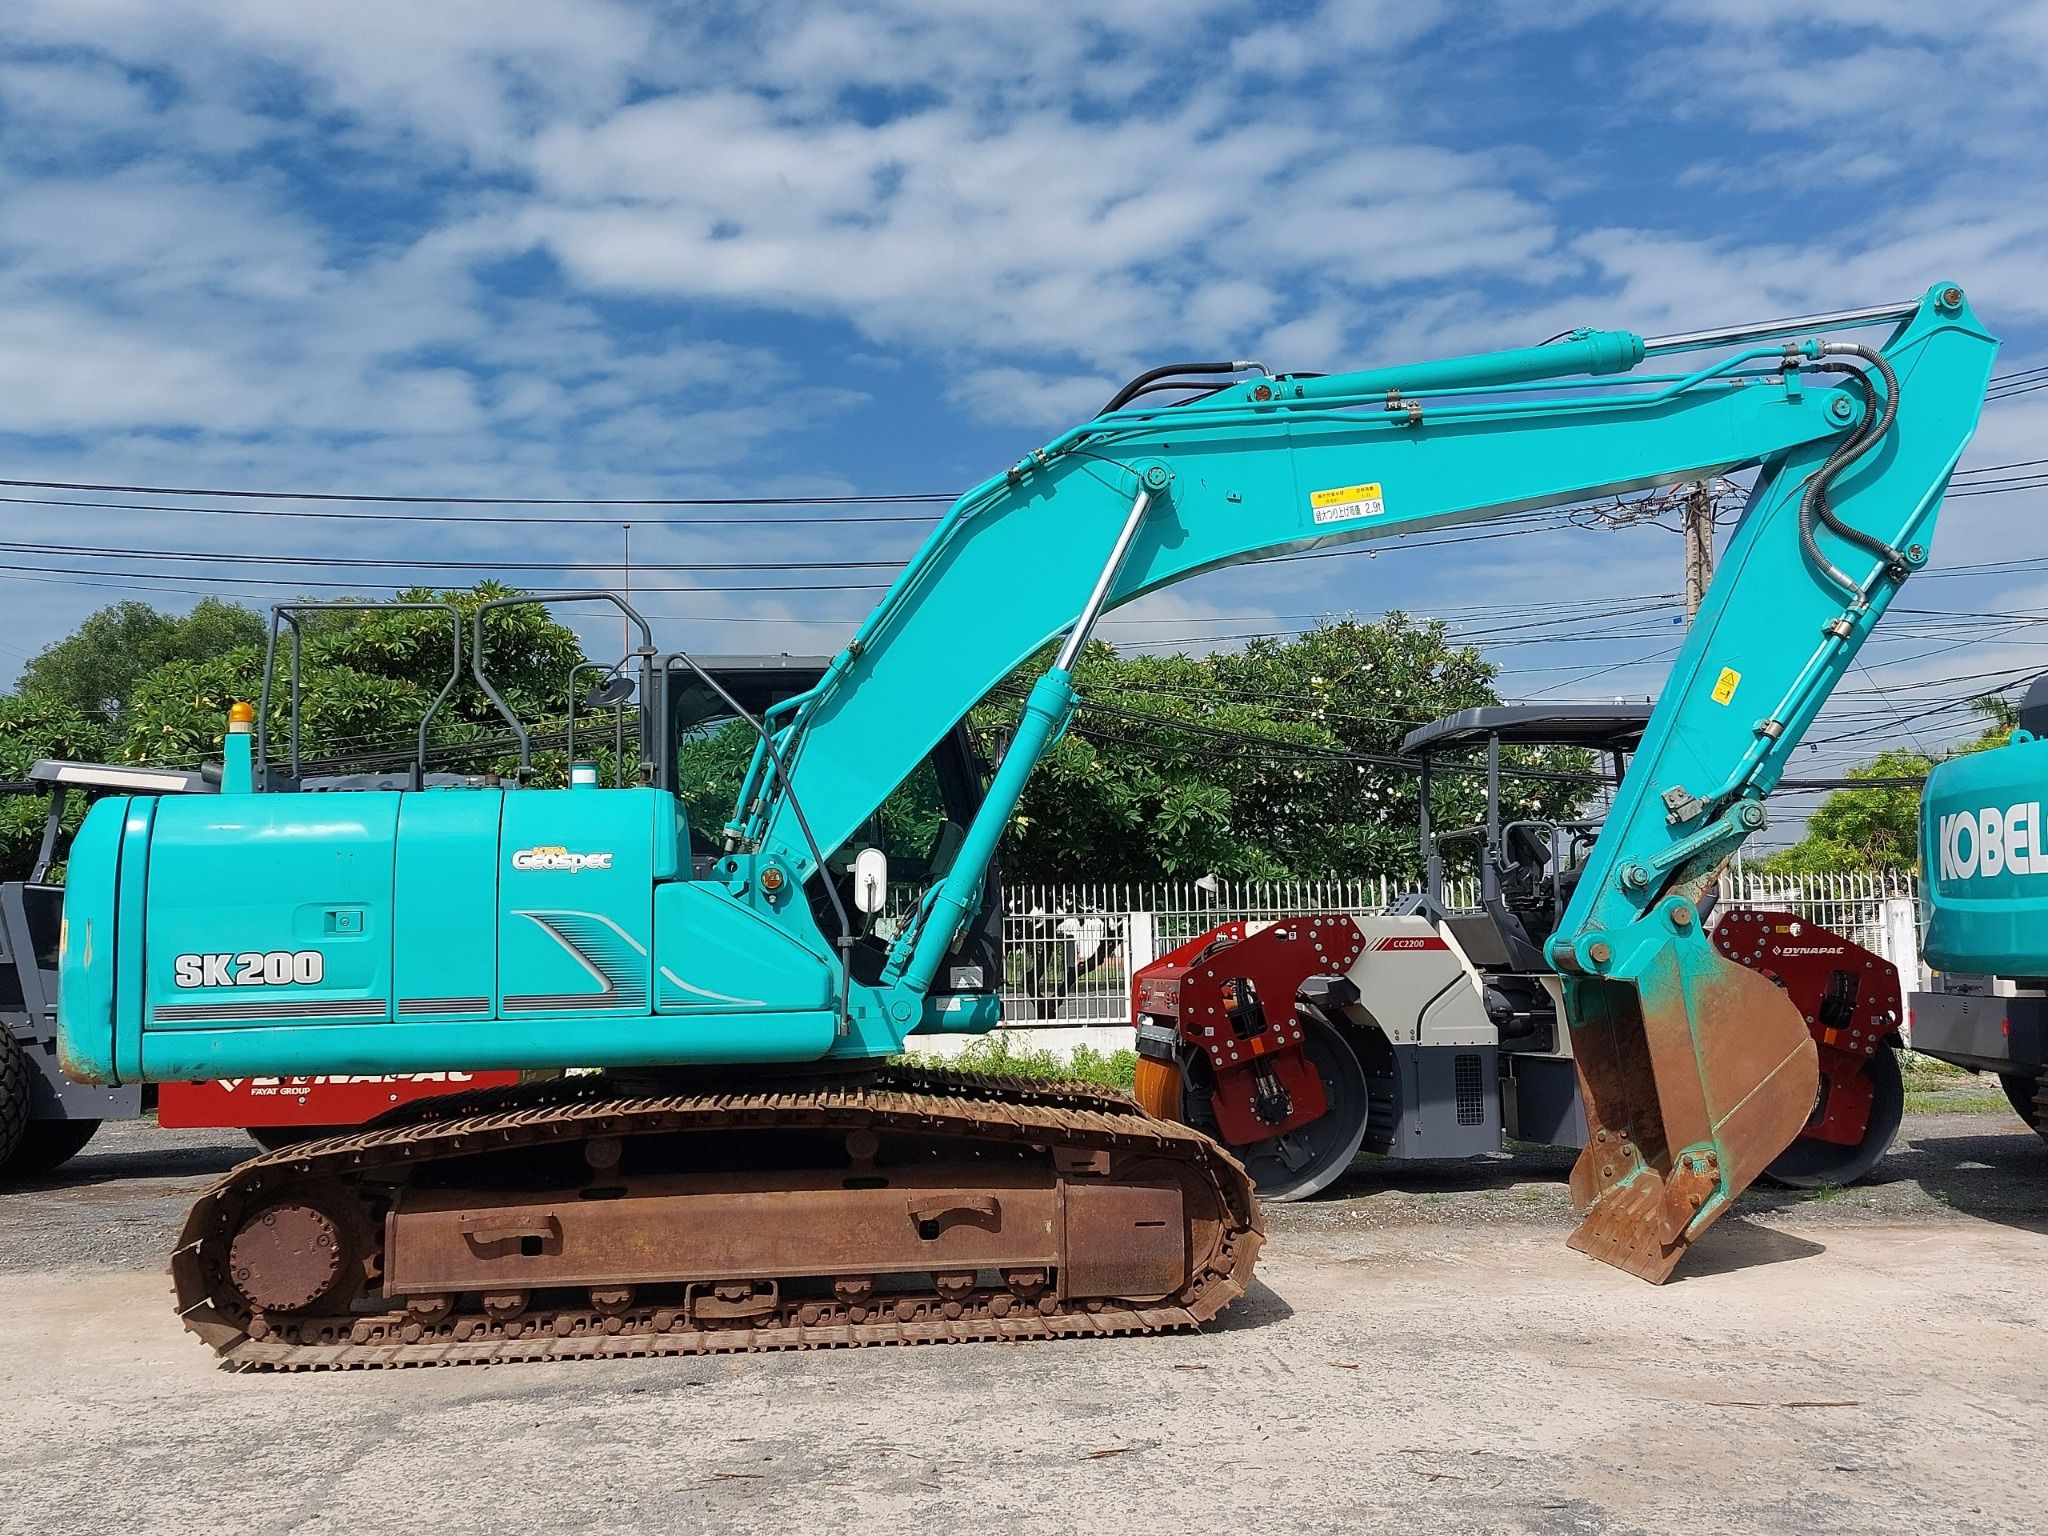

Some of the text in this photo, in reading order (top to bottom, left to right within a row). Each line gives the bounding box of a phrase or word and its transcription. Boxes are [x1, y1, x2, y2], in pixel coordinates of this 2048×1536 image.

[1365, 501, 1383, 514] 2.9t
[1940, 802, 2048, 880] KOBEL
[1393, 939, 1425, 948] CC2200
[174, 950, 324, 989] SK200
[250, 1087, 311, 1096] FAYAT GROUP
